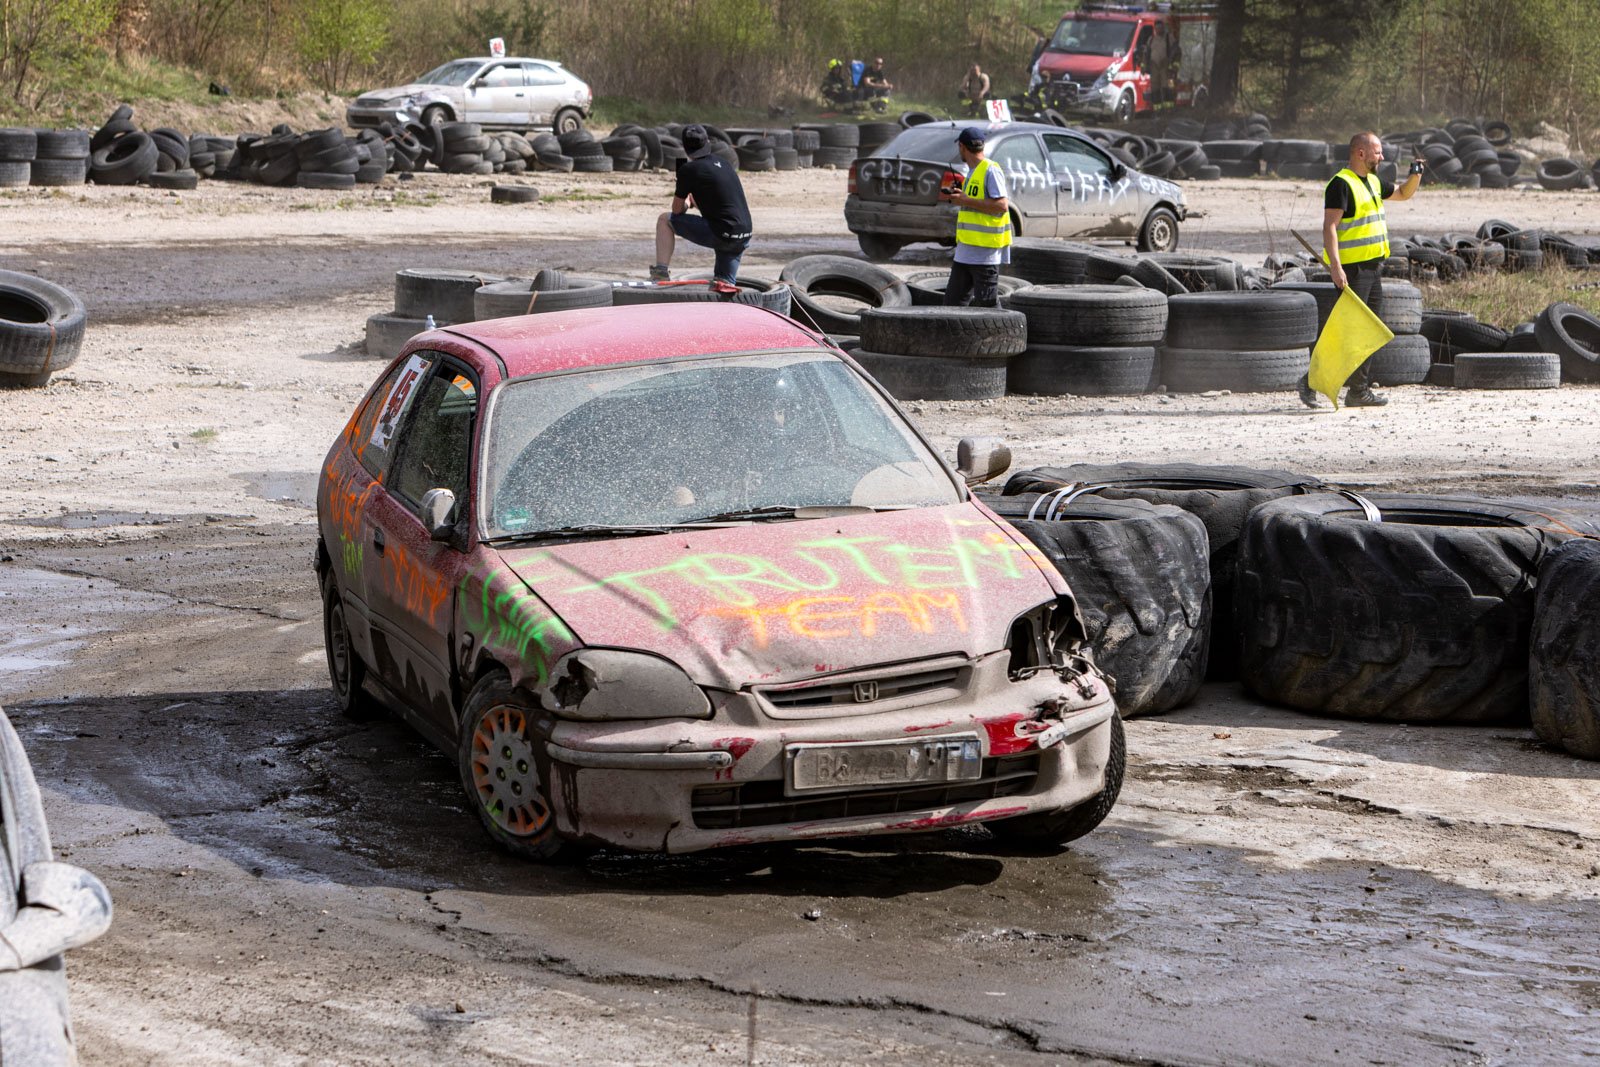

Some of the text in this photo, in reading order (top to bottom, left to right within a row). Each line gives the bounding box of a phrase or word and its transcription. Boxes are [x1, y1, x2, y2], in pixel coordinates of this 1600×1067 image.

[968, 185, 979, 197] 10
[1006, 157, 1131, 206] HALIFAX
[706, 590, 968, 648] TEAM
